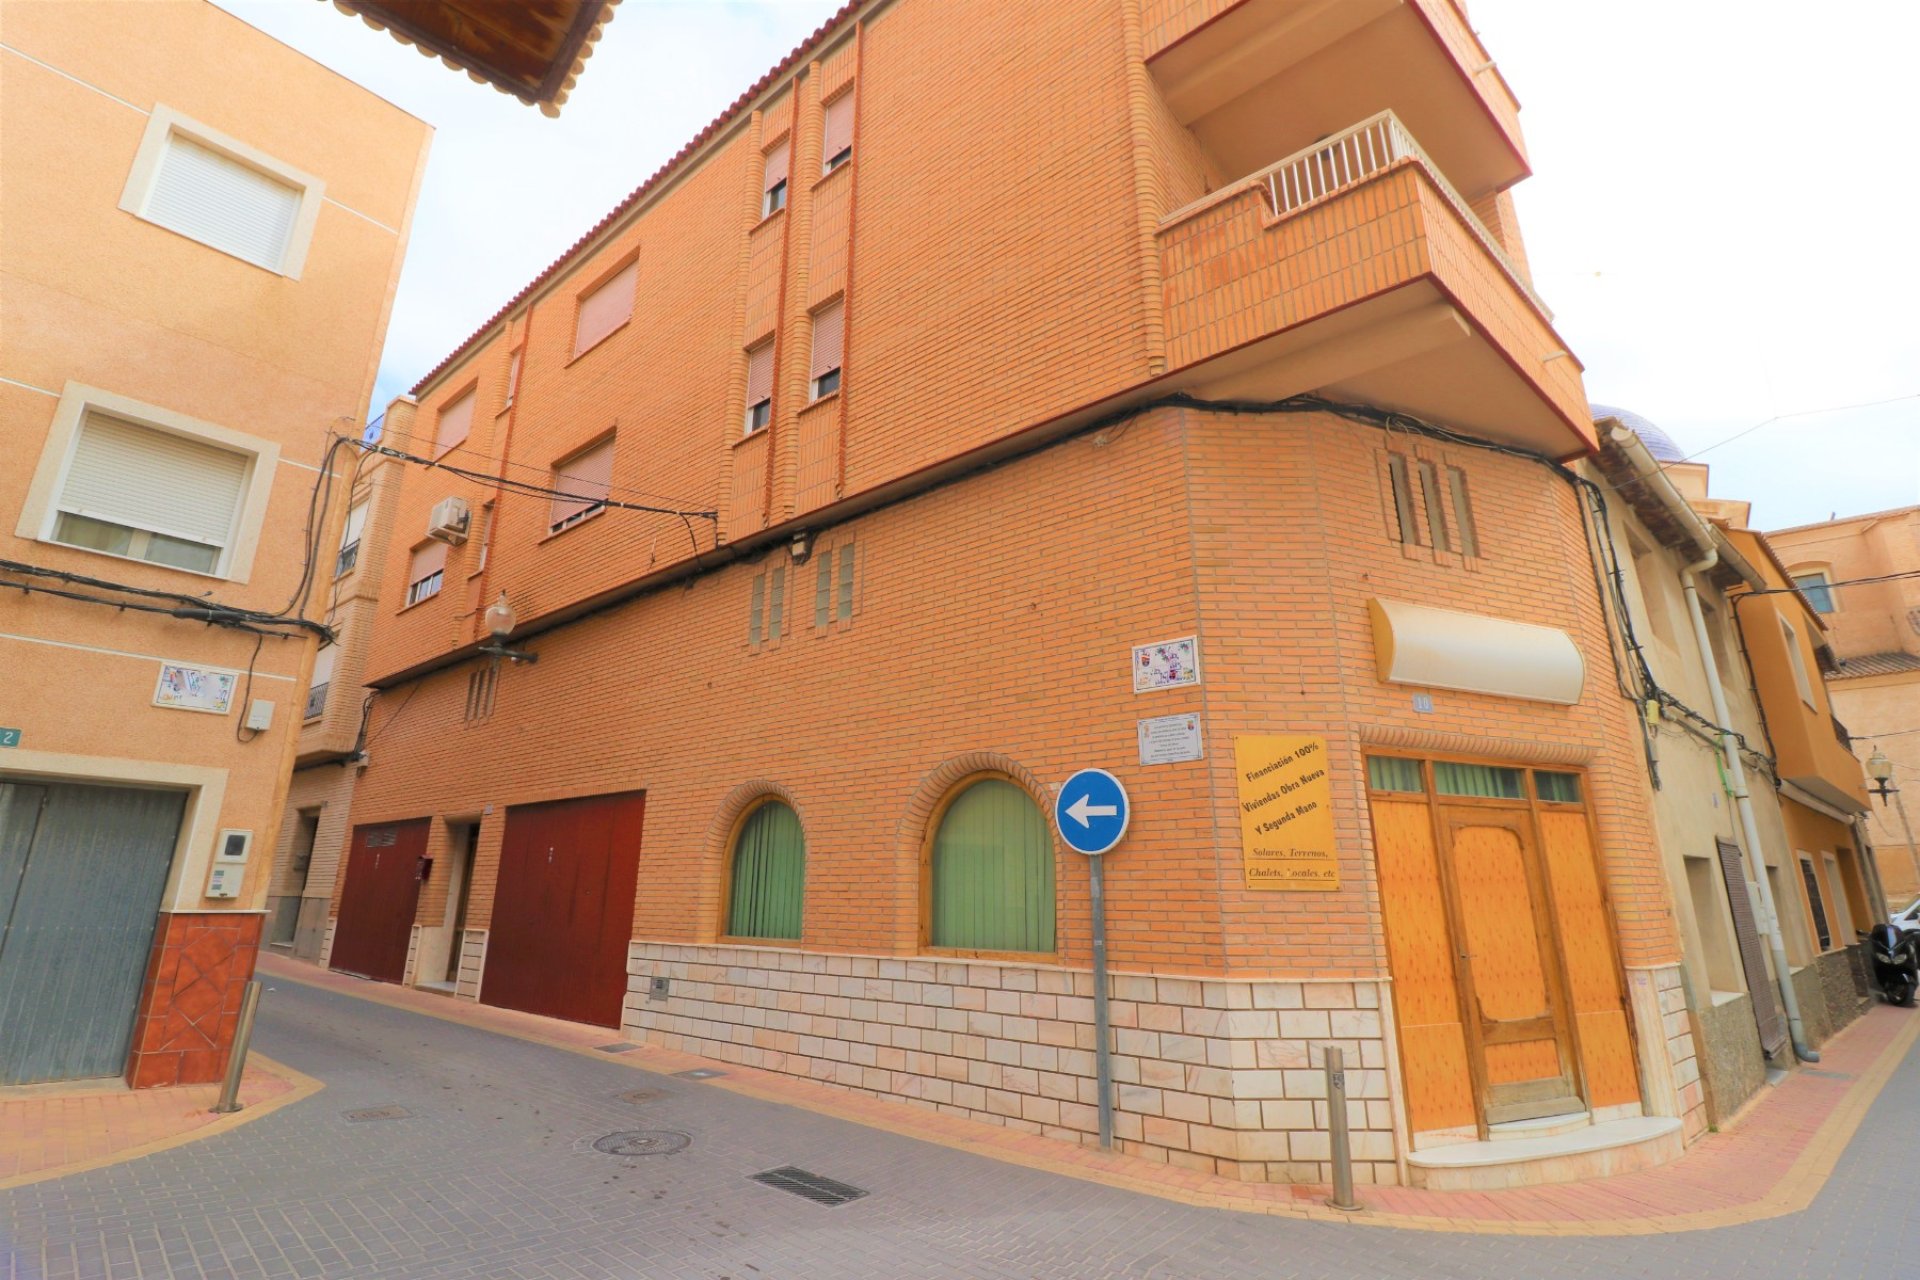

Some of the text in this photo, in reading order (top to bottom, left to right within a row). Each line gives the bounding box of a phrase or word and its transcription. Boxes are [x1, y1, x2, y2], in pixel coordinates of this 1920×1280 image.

[4, 731, 13, 744] 2
[1294, 741, 1319, 758] 100%
[1242, 769, 1325, 812] Viviendas Obra Nueva
[1254, 801, 1317, 835] Y Segunda Mano
